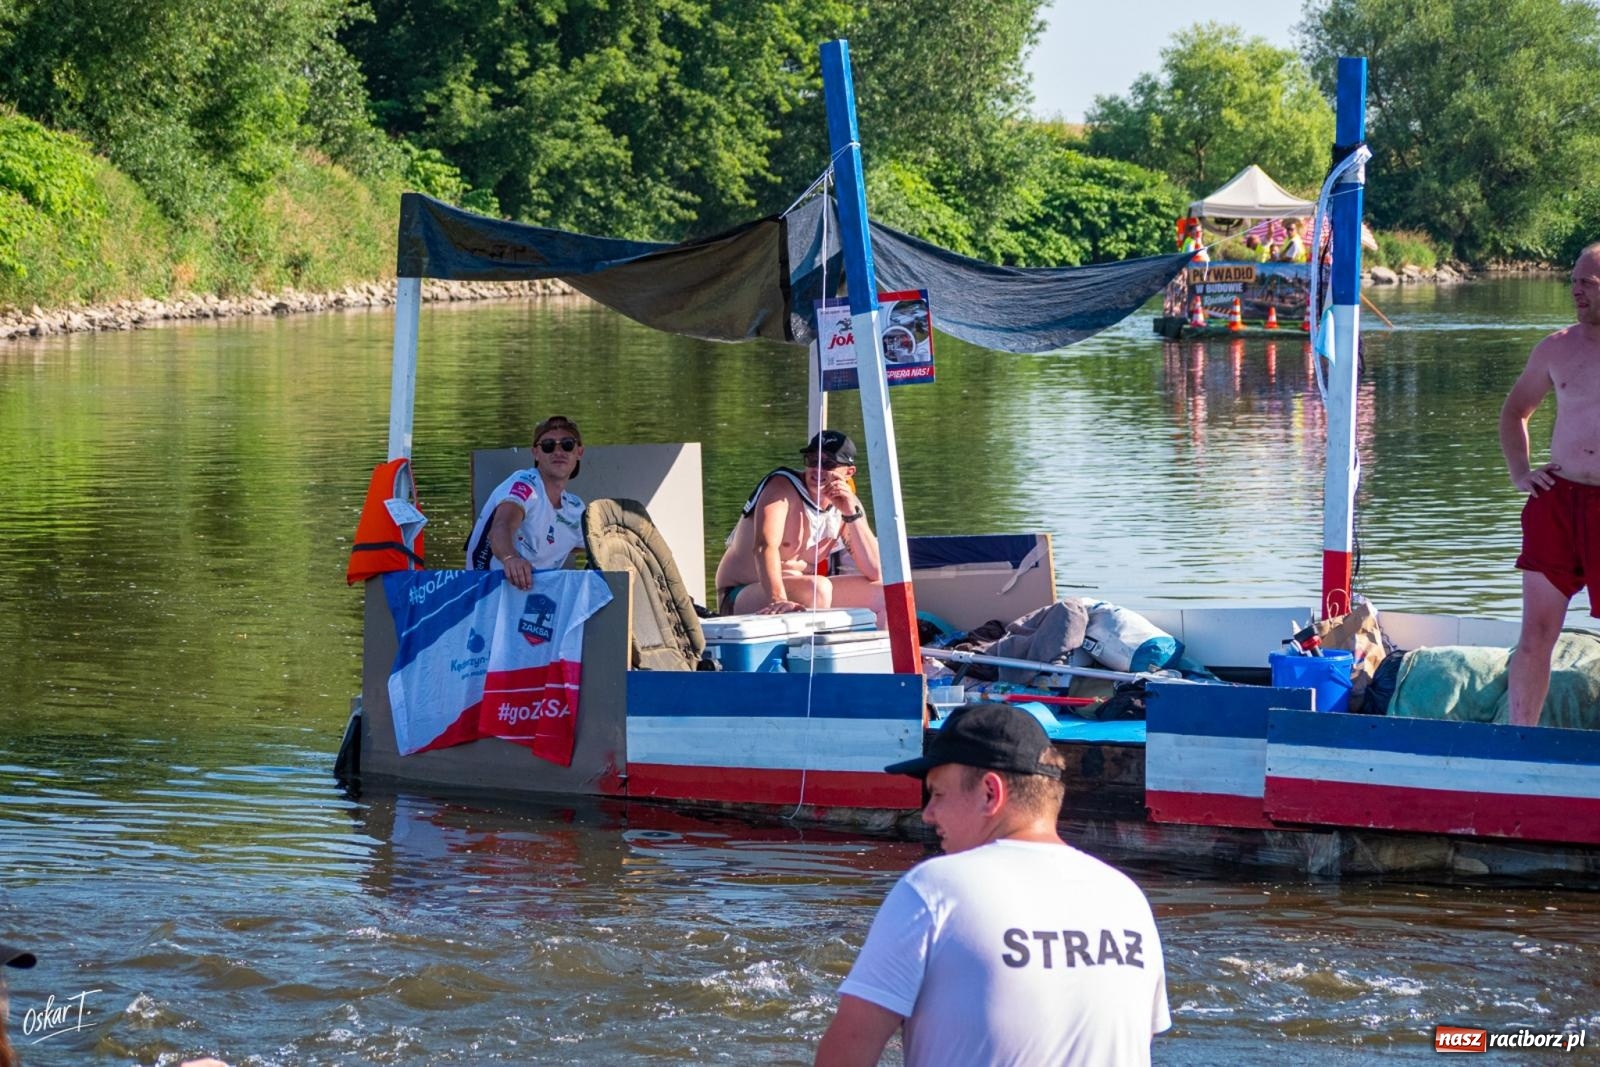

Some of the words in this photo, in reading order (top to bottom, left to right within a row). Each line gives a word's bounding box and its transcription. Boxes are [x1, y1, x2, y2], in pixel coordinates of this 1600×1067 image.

[1195, 284, 1204, 294] W
[1205, 283, 1243, 293] BUDOWIE
[911, 367, 930, 377] NAS!
[521, 622, 549, 638] ZAKSA
